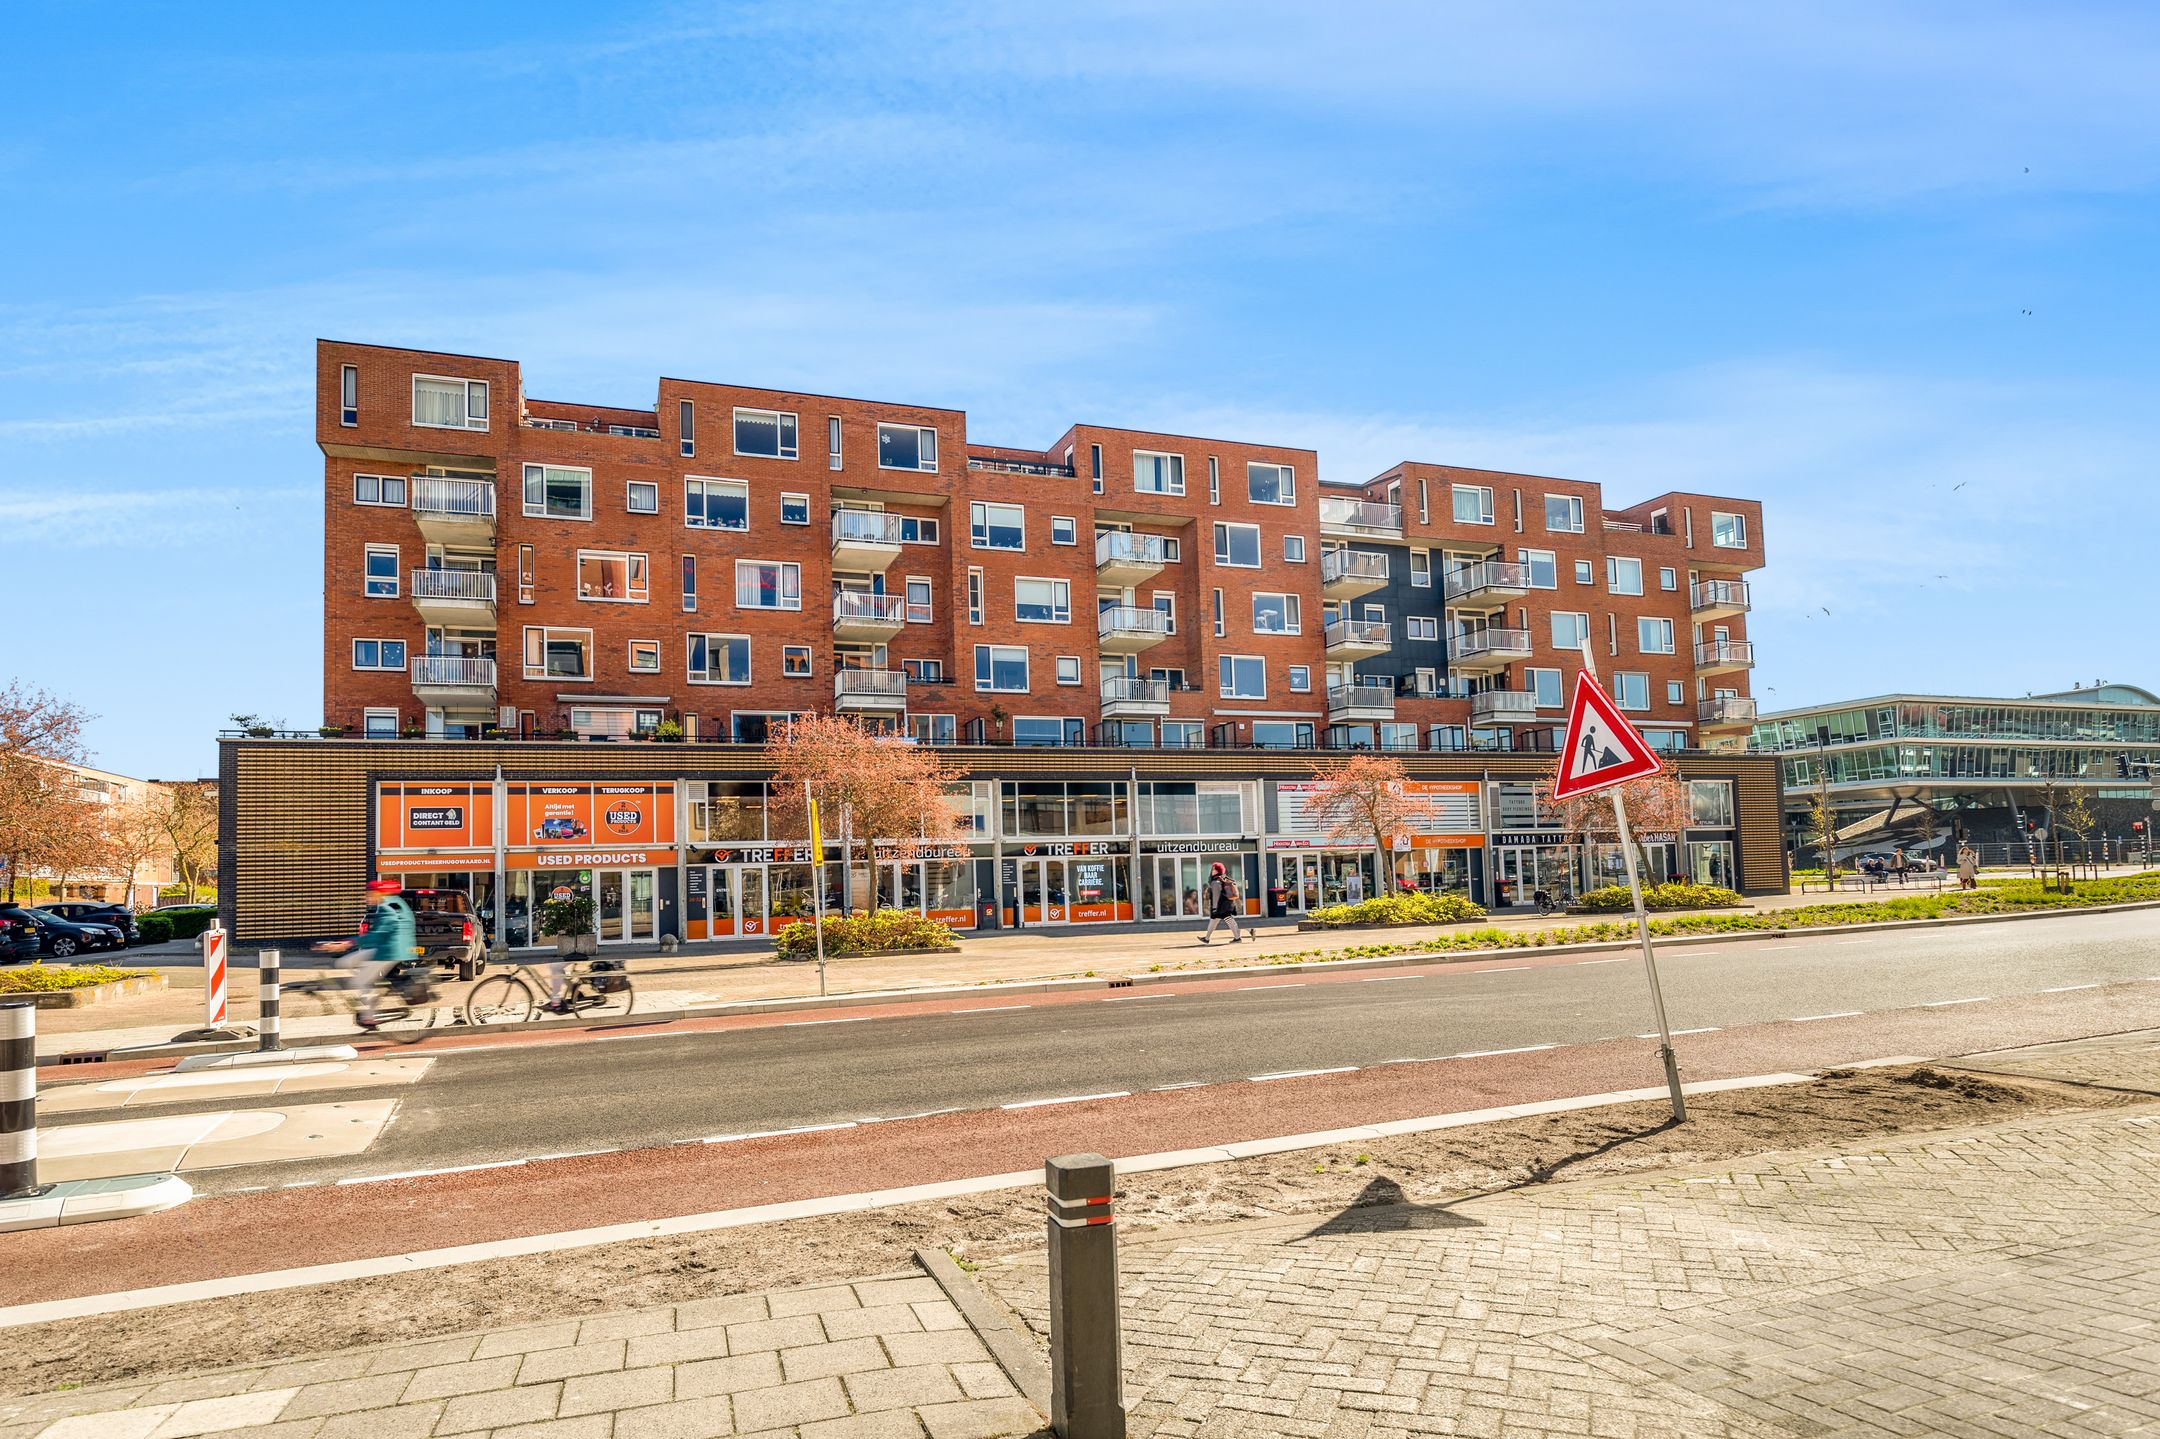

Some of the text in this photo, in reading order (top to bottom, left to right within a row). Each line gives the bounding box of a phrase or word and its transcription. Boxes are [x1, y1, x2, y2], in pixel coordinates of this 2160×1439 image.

[610, 812, 637, 820] USED
[1502, 835, 1536, 844] DAMADA
[1045, 842, 1109, 856] TREFFER
[1157, 841, 1239, 853] uitzendbureau
[537, 853, 647, 865] USED PRODUCTS
[740, 848, 812, 862] TREFFER
[935, 915, 966, 923] treffer.nl
